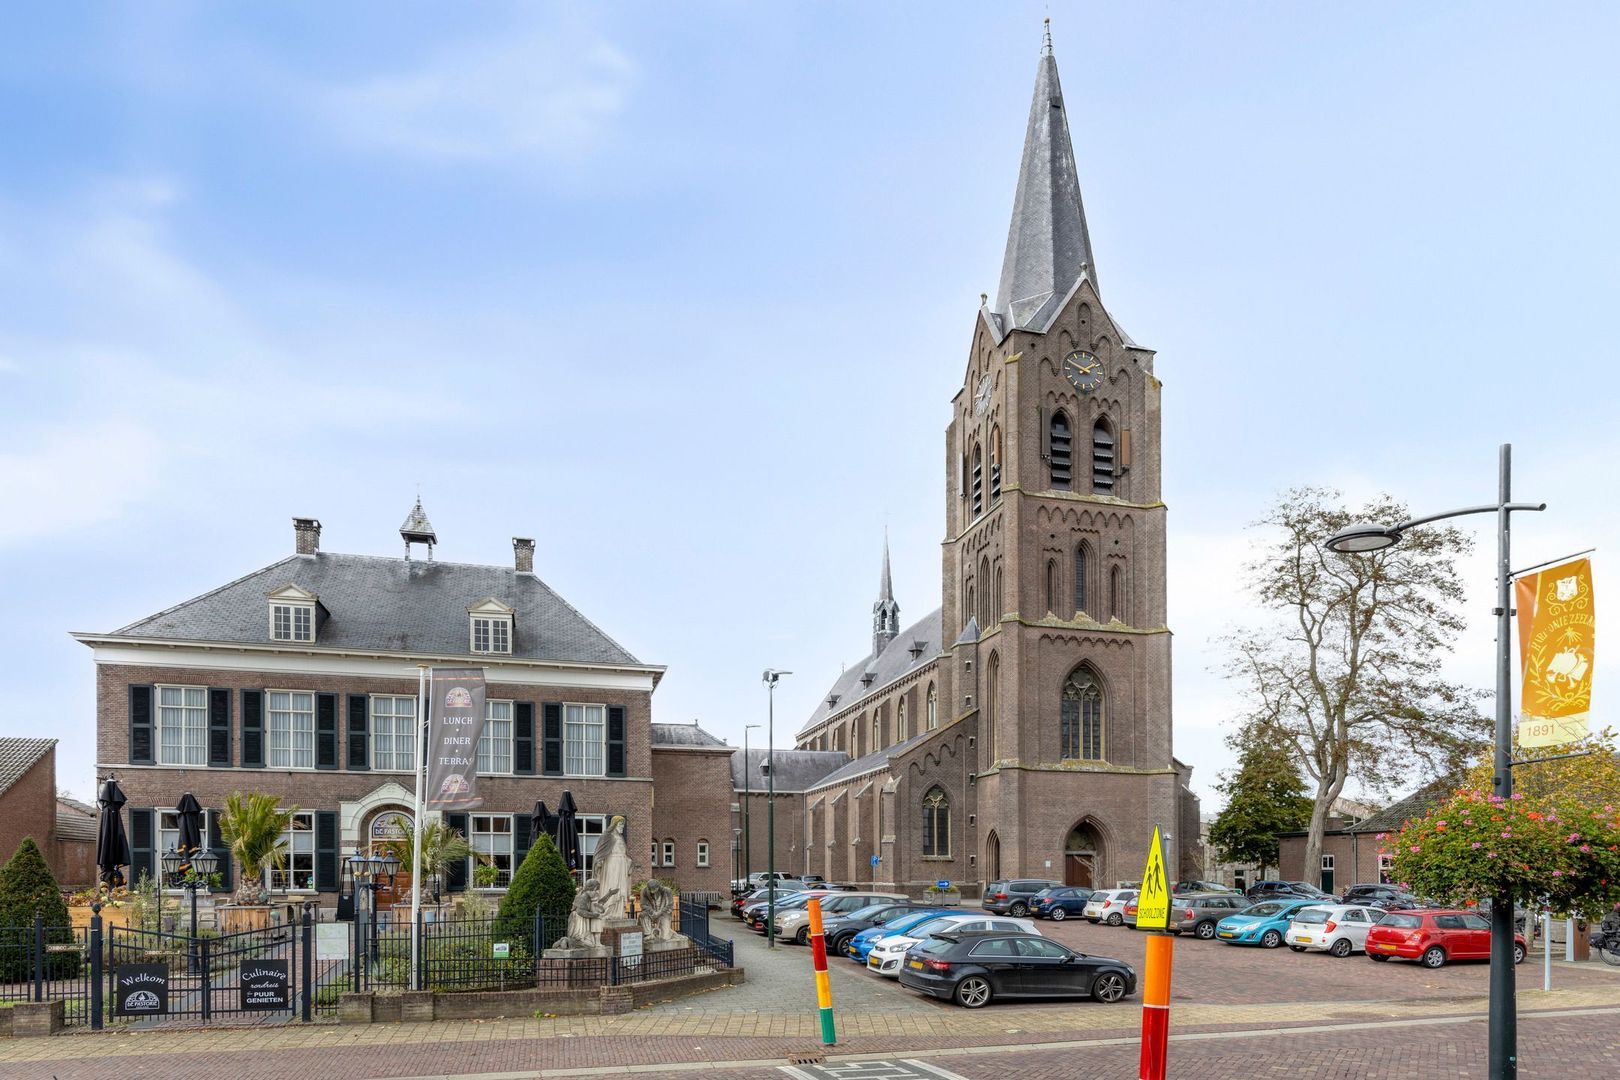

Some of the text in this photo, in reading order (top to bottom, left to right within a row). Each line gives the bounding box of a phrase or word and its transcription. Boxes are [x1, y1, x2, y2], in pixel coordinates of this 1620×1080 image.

[443, 716, 473, 725] LUNCH
[1527, 724, 1555, 737] 1891
[443, 736, 471, 745] DINER
[121, 972, 166, 987] Welkom
[241, 968, 287, 981] Culinaire
